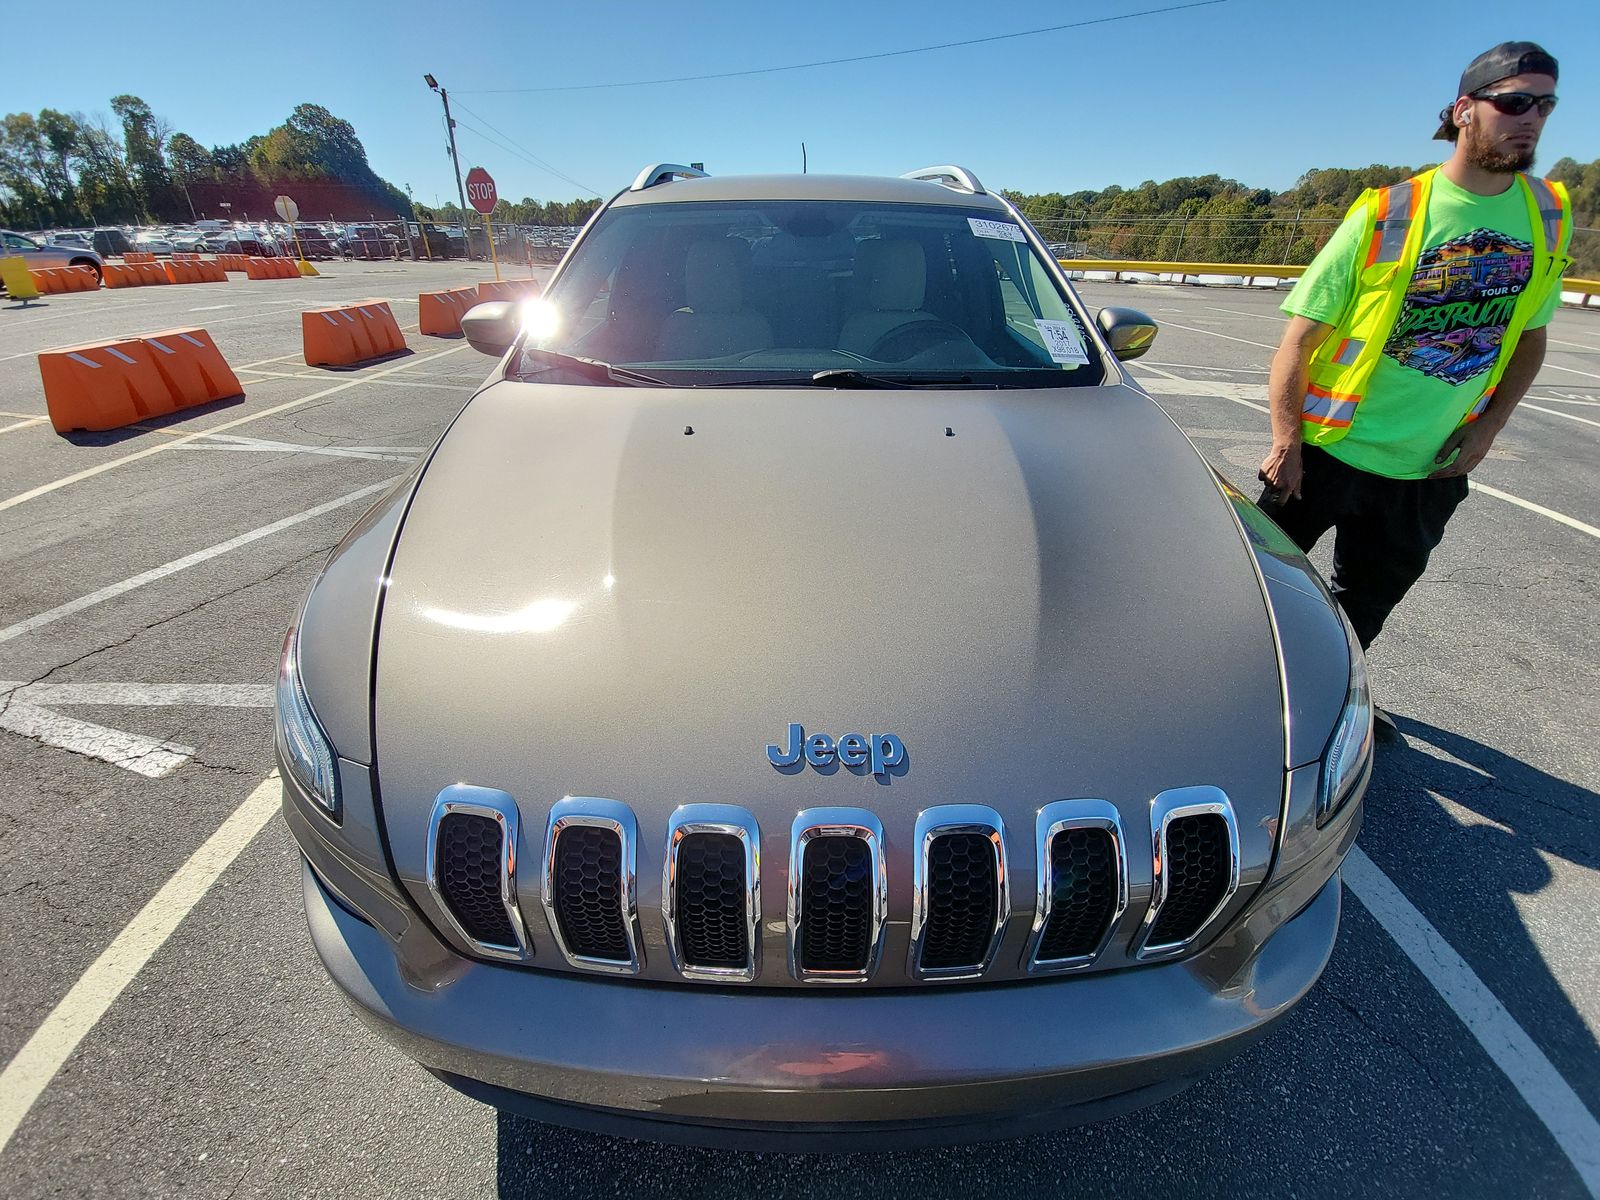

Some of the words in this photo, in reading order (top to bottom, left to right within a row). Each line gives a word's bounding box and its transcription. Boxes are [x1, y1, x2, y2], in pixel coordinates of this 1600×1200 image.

[468, 182, 494, 200] STOP
[1481, 286, 1509, 297] TOUR
[765, 722, 904, 774] Jeep
